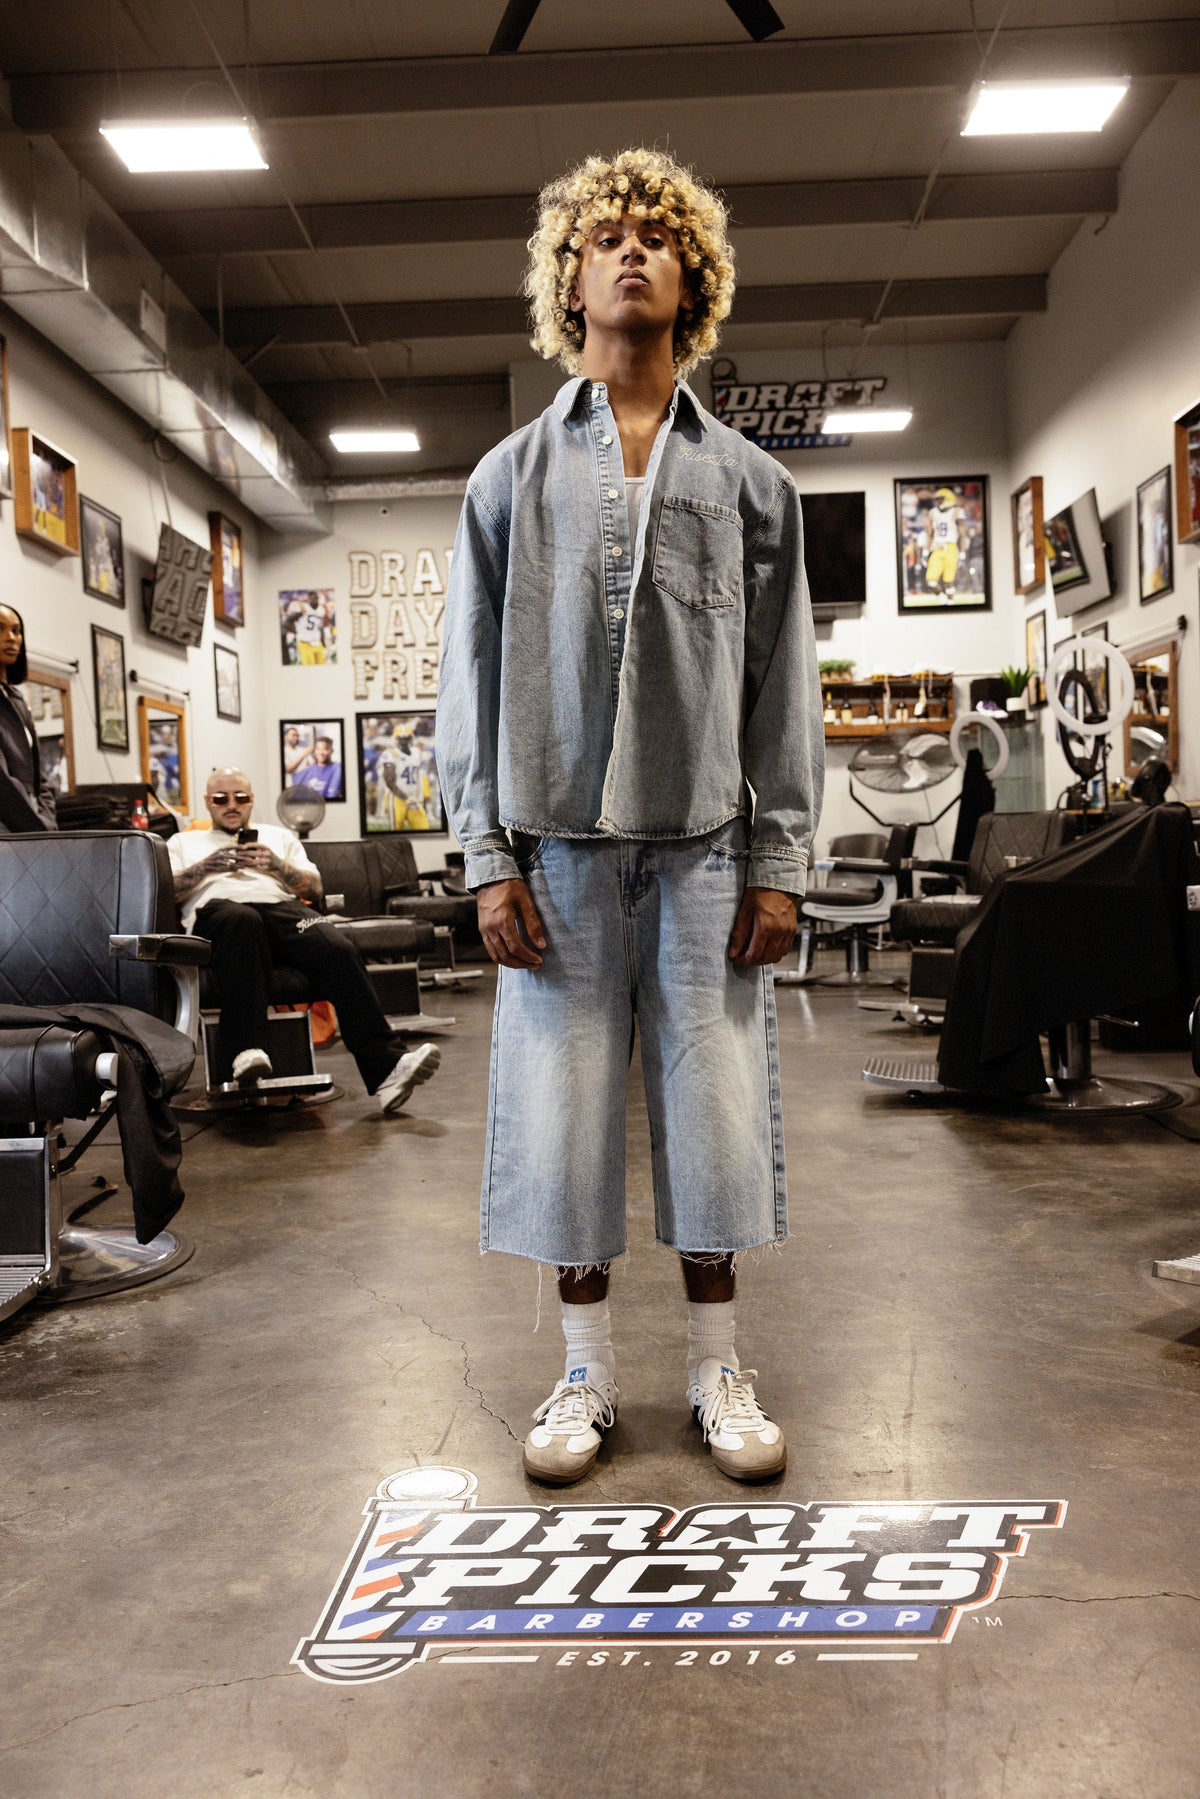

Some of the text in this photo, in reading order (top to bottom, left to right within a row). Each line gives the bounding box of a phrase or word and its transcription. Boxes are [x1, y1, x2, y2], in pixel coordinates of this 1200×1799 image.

[725, 379, 886, 411] DRAFT
[730, 409, 836, 436] PICK
[350, 598, 445, 649] DAY
[395, 1505, 1047, 1555] DRAFT
[386, 1553, 986, 1606] PICKS
[417, 1610, 921, 1632] BARBERSHOP
[555, 1650, 797, 1666] EST. 2016
